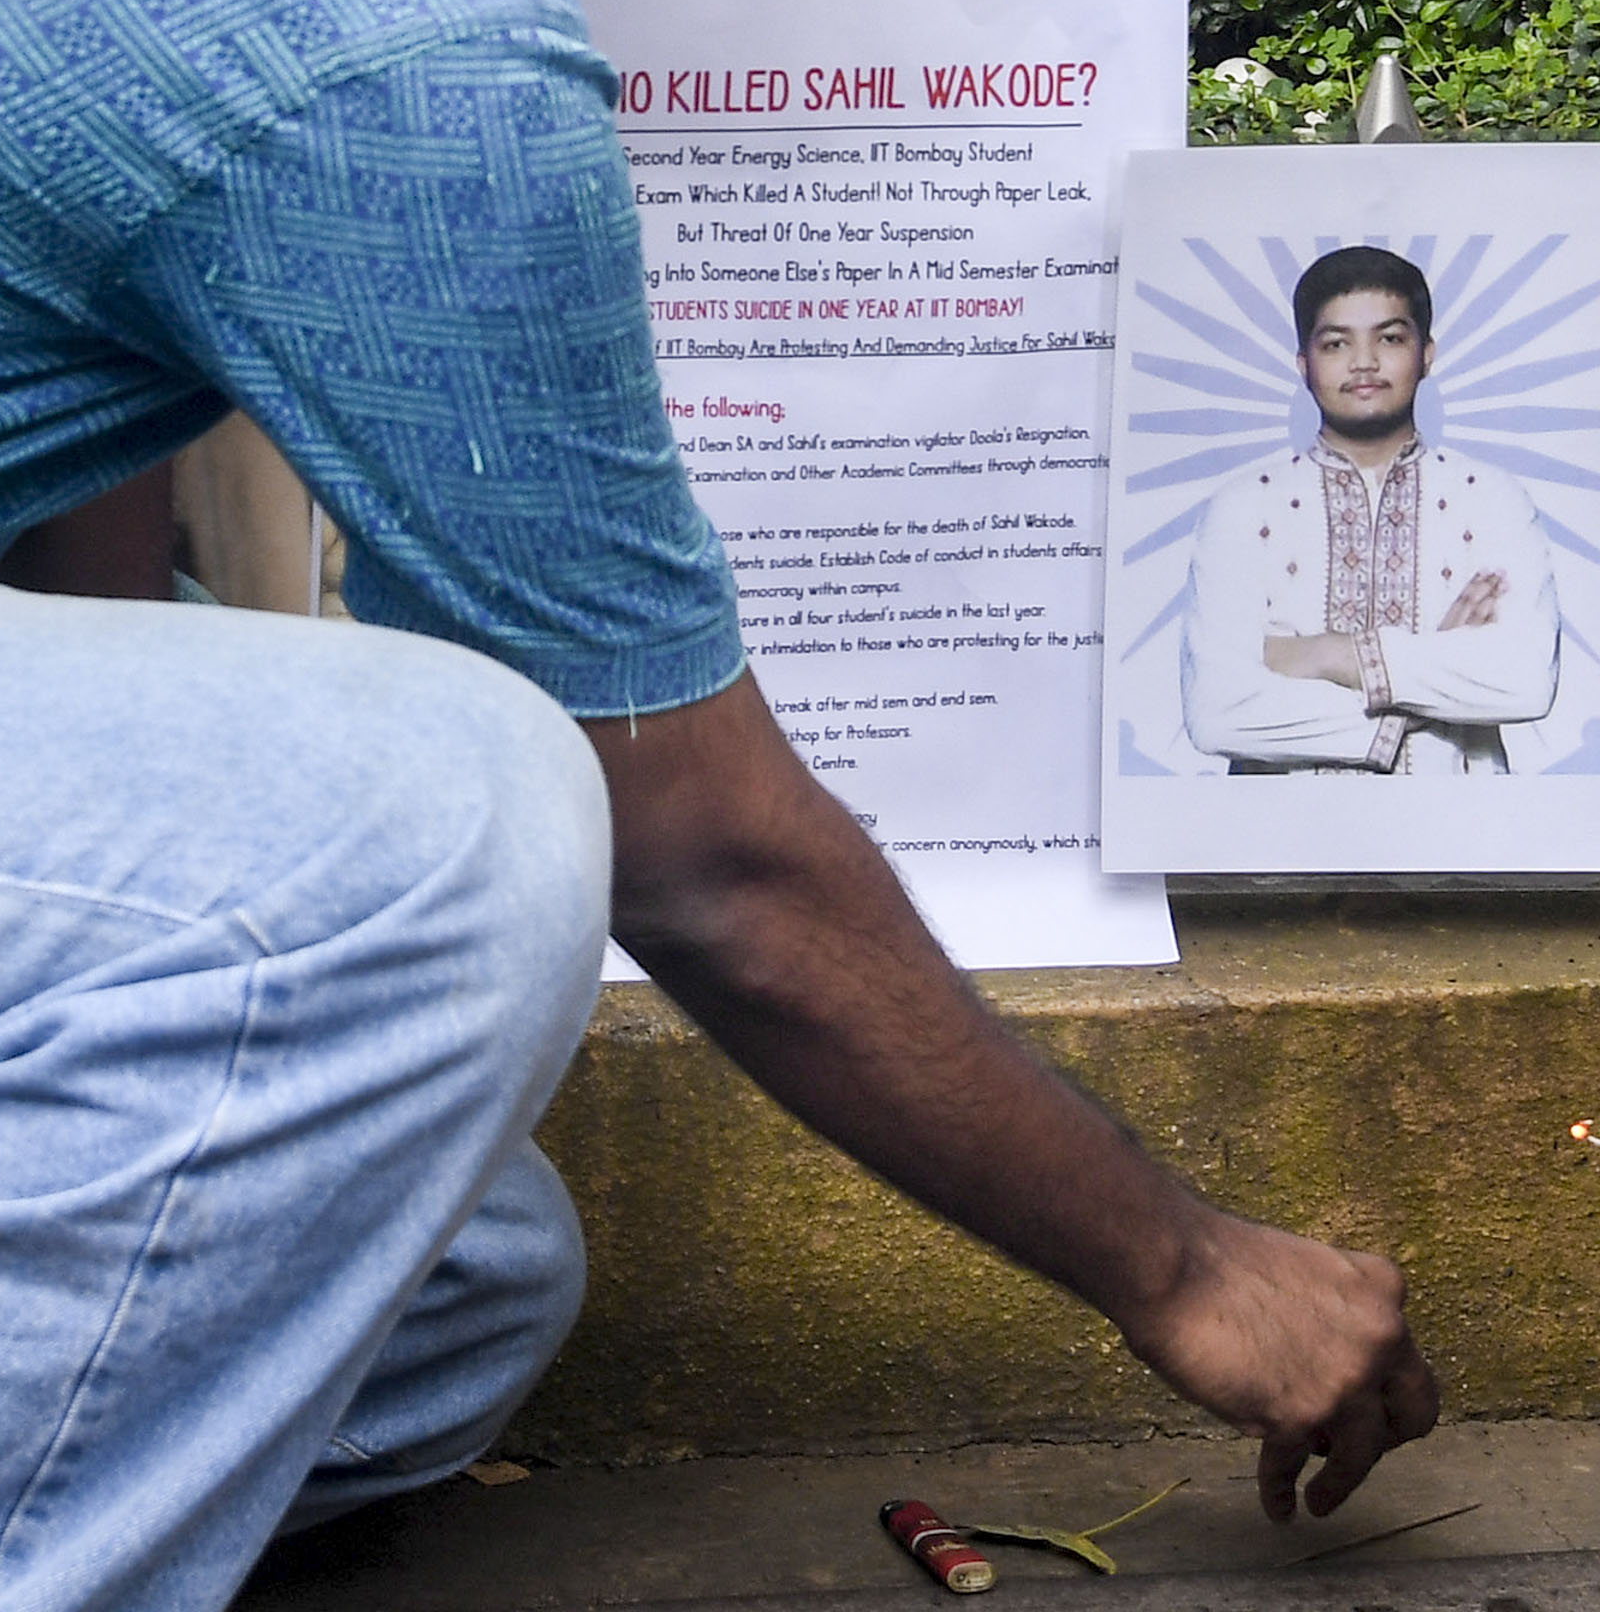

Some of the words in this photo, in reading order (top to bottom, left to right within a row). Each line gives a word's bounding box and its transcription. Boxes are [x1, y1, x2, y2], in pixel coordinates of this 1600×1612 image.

[667, 70, 789, 114] KILLED
[804, 67, 905, 112] SAHIL
[923, 62, 1098, 110] WAKODE?
[689, 146, 725, 165] Year
[732, 145, 791, 169] Energy
[871, 143, 889, 162] IIT
[896, 143, 962, 167] Bombay
[969, 142, 1033, 162] Student
[636, 184, 682, 204] Exam
[688, 184, 738, 203] Which
[744, 184, 788, 203] Killed
[794, 184, 806, 202] A
[886, 182, 913, 201] Not
[920, 181, 990, 207] Through
[996, 181, 1041, 207] Paper
[677, 223, 703, 243] But
[711, 222, 767, 242] Threat
[773, 222, 793, 242] Of
[799, 222, 831, 242] One
[838, 221, 874, 242] Year
[881, 221, 974, 247] Suspension
[665, 262, 695, 281] Into
[701, 262, 780, 281] Someone
[786, 260, 830, 281] Else's
[836, 261, 882, 287] Paper
[889, 261, 902, 280] In
[908, 260, 921, 279] A
[927, 260, 954, 279] Mid
[960, 259, 1039, 279] Semester
[1045, 256, 1119, 278] Examinat
[734, 299, 792, 320] SUICIDE
[798, 299, 813, 319] IN
[819, 298, 849, 319] ONE
[856, 298, 899, 319] YEAR
[904, 298, 924, 318] AT
[931, 298, 950, 318] IIT
[688, 338, 745, 359] Bombay
[750, 339, 776, 356] Are
[780, 338, 848, 358] Protesting
[853, 336, 883, 354] And
[887, 337, 965, 356] Demanding
[970, 336, 1018, 353] Justice
[1022, 333, 1042, 350] For
[1047, 331, 1078, 348] Sahil
[665, 398, 695, 418] the
[678, 437, 695, 452] nd
[699, 437, 733, 452] Dean
[736, 436, 753, 451] SA
[758, 435, 784, 450] and
[831, 431, 910, 449] examination
[915, 431, 965, 451] vigilator
[771, 465, 796, 481] and
[800, 464, 836, 479] Other
[841, 463, 904, 479] Academic
[909, 460, 983, 477] Committees
[987, 456, 1036, 475] through
[747, 526, 775, 540] who
[779, 527, 801, 540] are
[806, 522, 879, 542] responsible
[884, 521, 902, 536] for
[907, 520, 928, 535] the
[932, 518, 969, 534] death
[973, 515, 987, 531] of
[991, 514, 1020, 530] Sahil
[820, 551, 875, 567] Establish
[879, 549, 911, 565] Code
[915, 548, 929, 563] of
[934, 545, 983, 562] conduct
[987, 545, 999, 559] in
[1003, 543, 1057, 559] students
[737, 584, 803, 601] emocracy
[808, 581, 847, 597] within
[773, 614, 785, 626] in
[789, 610, 803, 626] all
[808, 610, 833, 625] four
[838, 606, 895, 624] student's
[900, 605, 942, 621] suicide
[947, 606, 957, 618] in
[962, 603, 983, 618] the
[987, 602, 1010, 618] last
[761, 639, 836, 655] intimidation
[841, 637, 853, 652] to
[858, 636, 892, 651] those
[897, 635, 923, 649] who
[927, 636, 949, 649] are
[953, 632, 1019, 652] protesting
[1024, 631, 1043, 646] for
[1048, 631, 1068, 646] the
[775, 697, 811, 713] break
[816, 696, 850, 712] after
[854, 694, 878, 710] mid
[882, 697, 909, 709] sem
[912, 692, 937, 708] and
[940, 691, 965, 707] end
[825, 725, 843, 740] for
[892, 839, 946, 852] concern
[1042, 832, 1080, 849] which
